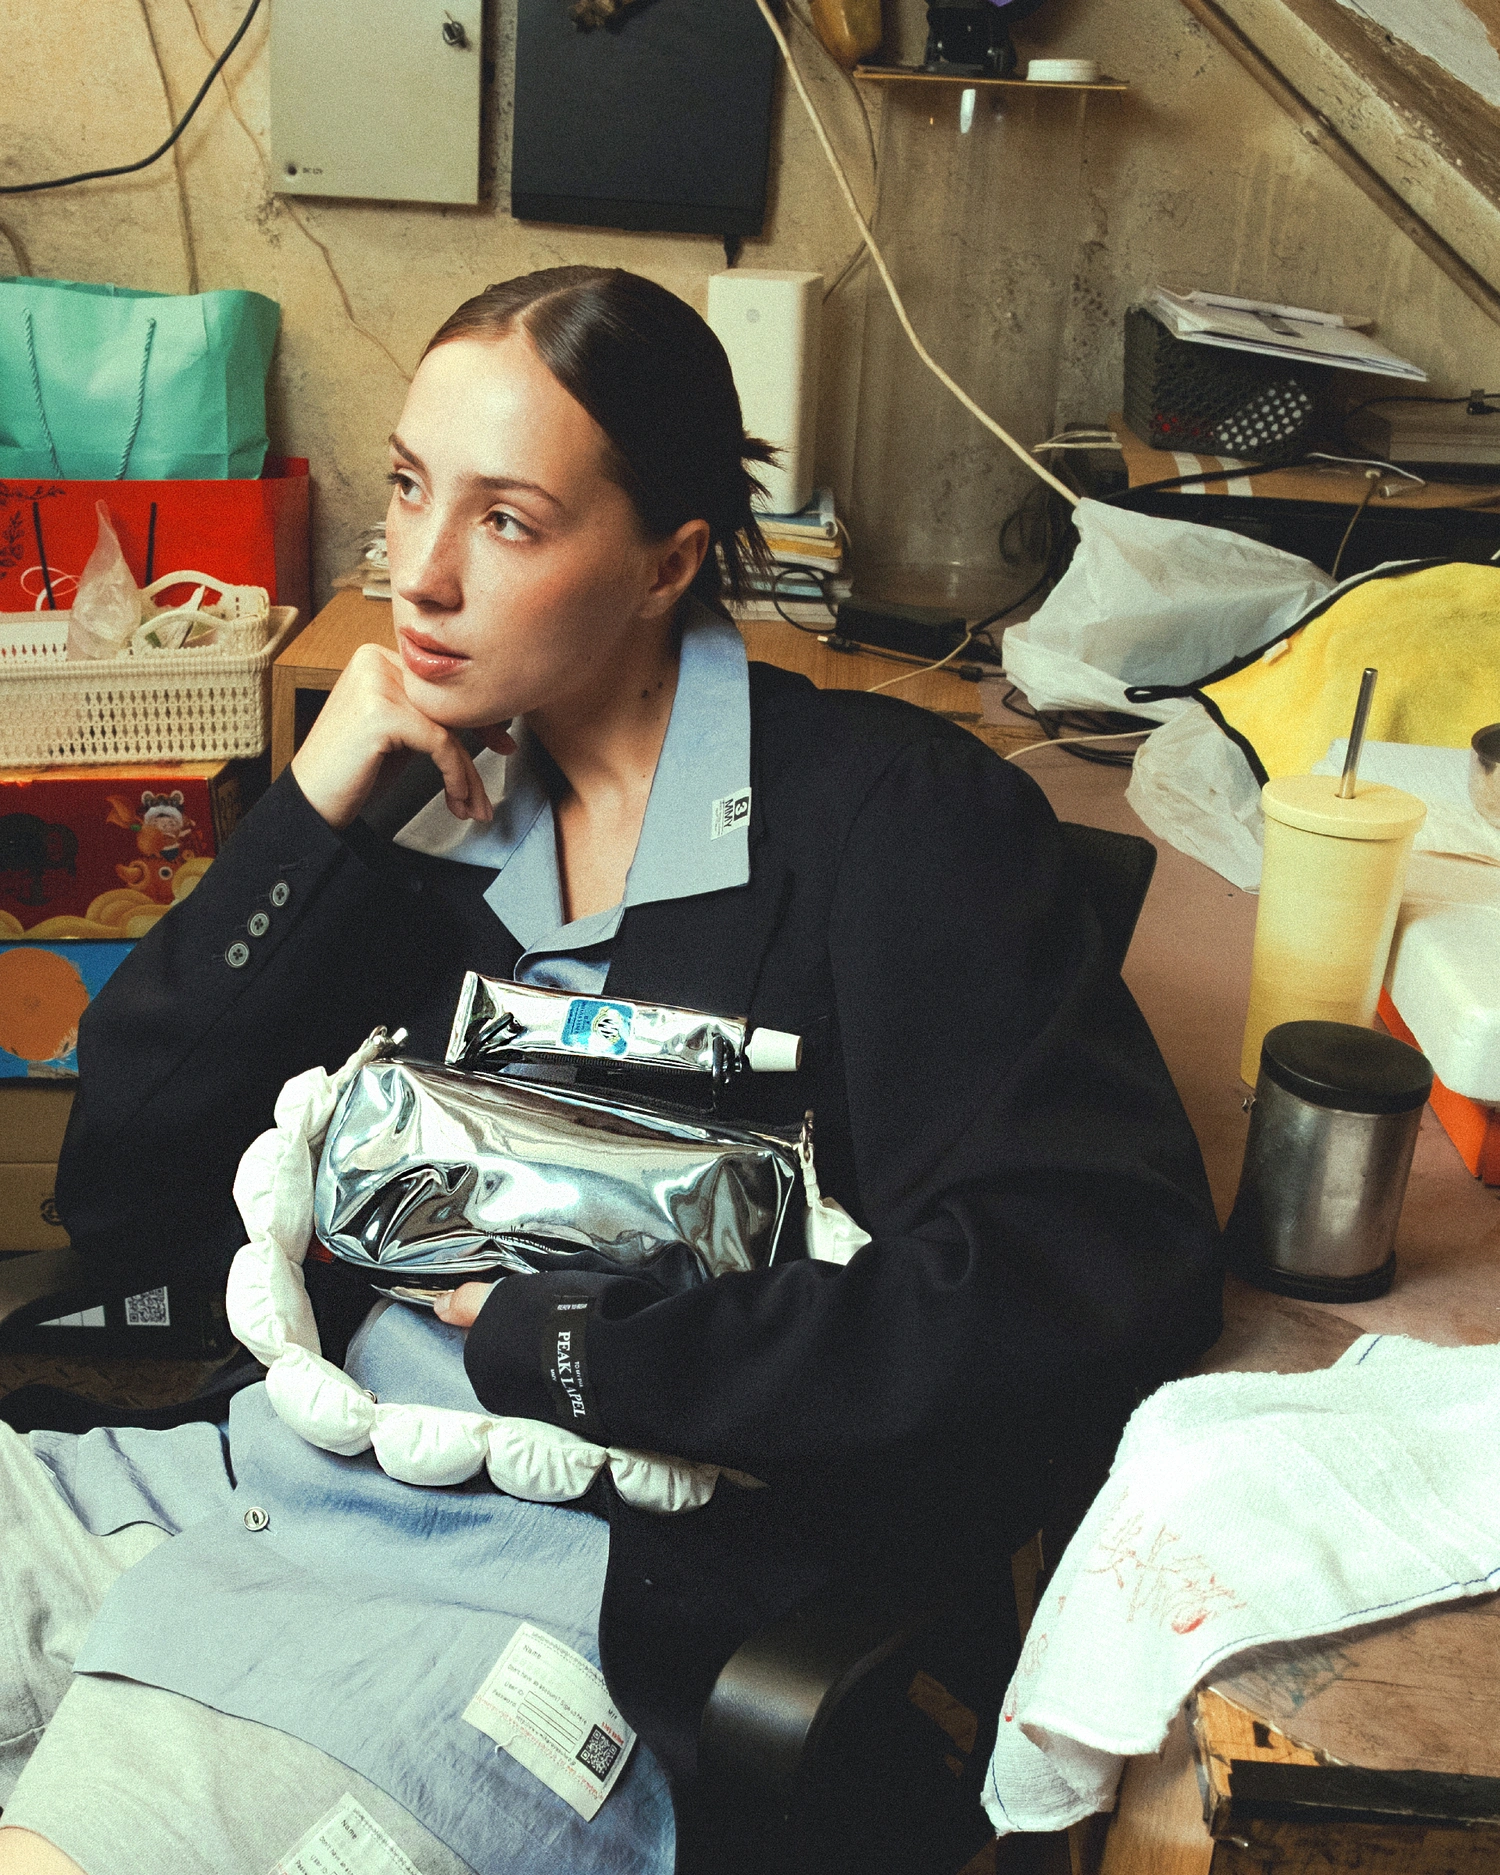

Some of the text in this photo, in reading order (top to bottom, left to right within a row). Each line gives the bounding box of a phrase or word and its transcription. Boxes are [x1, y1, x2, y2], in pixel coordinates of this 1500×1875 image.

[724, 798, 734, 828] MMY
[557, 1330, 586, 1418] PEAK LAPEL
[523, 1645, 541, 1659] Name
[508, 1664, 520, 1675] Don't
[520, 1672, 532, 1682] have
[504, 1681, 517, 1692] User
[341, 1819, 357, 1839] Name
[319, 1836, 332, 1850] Don't
